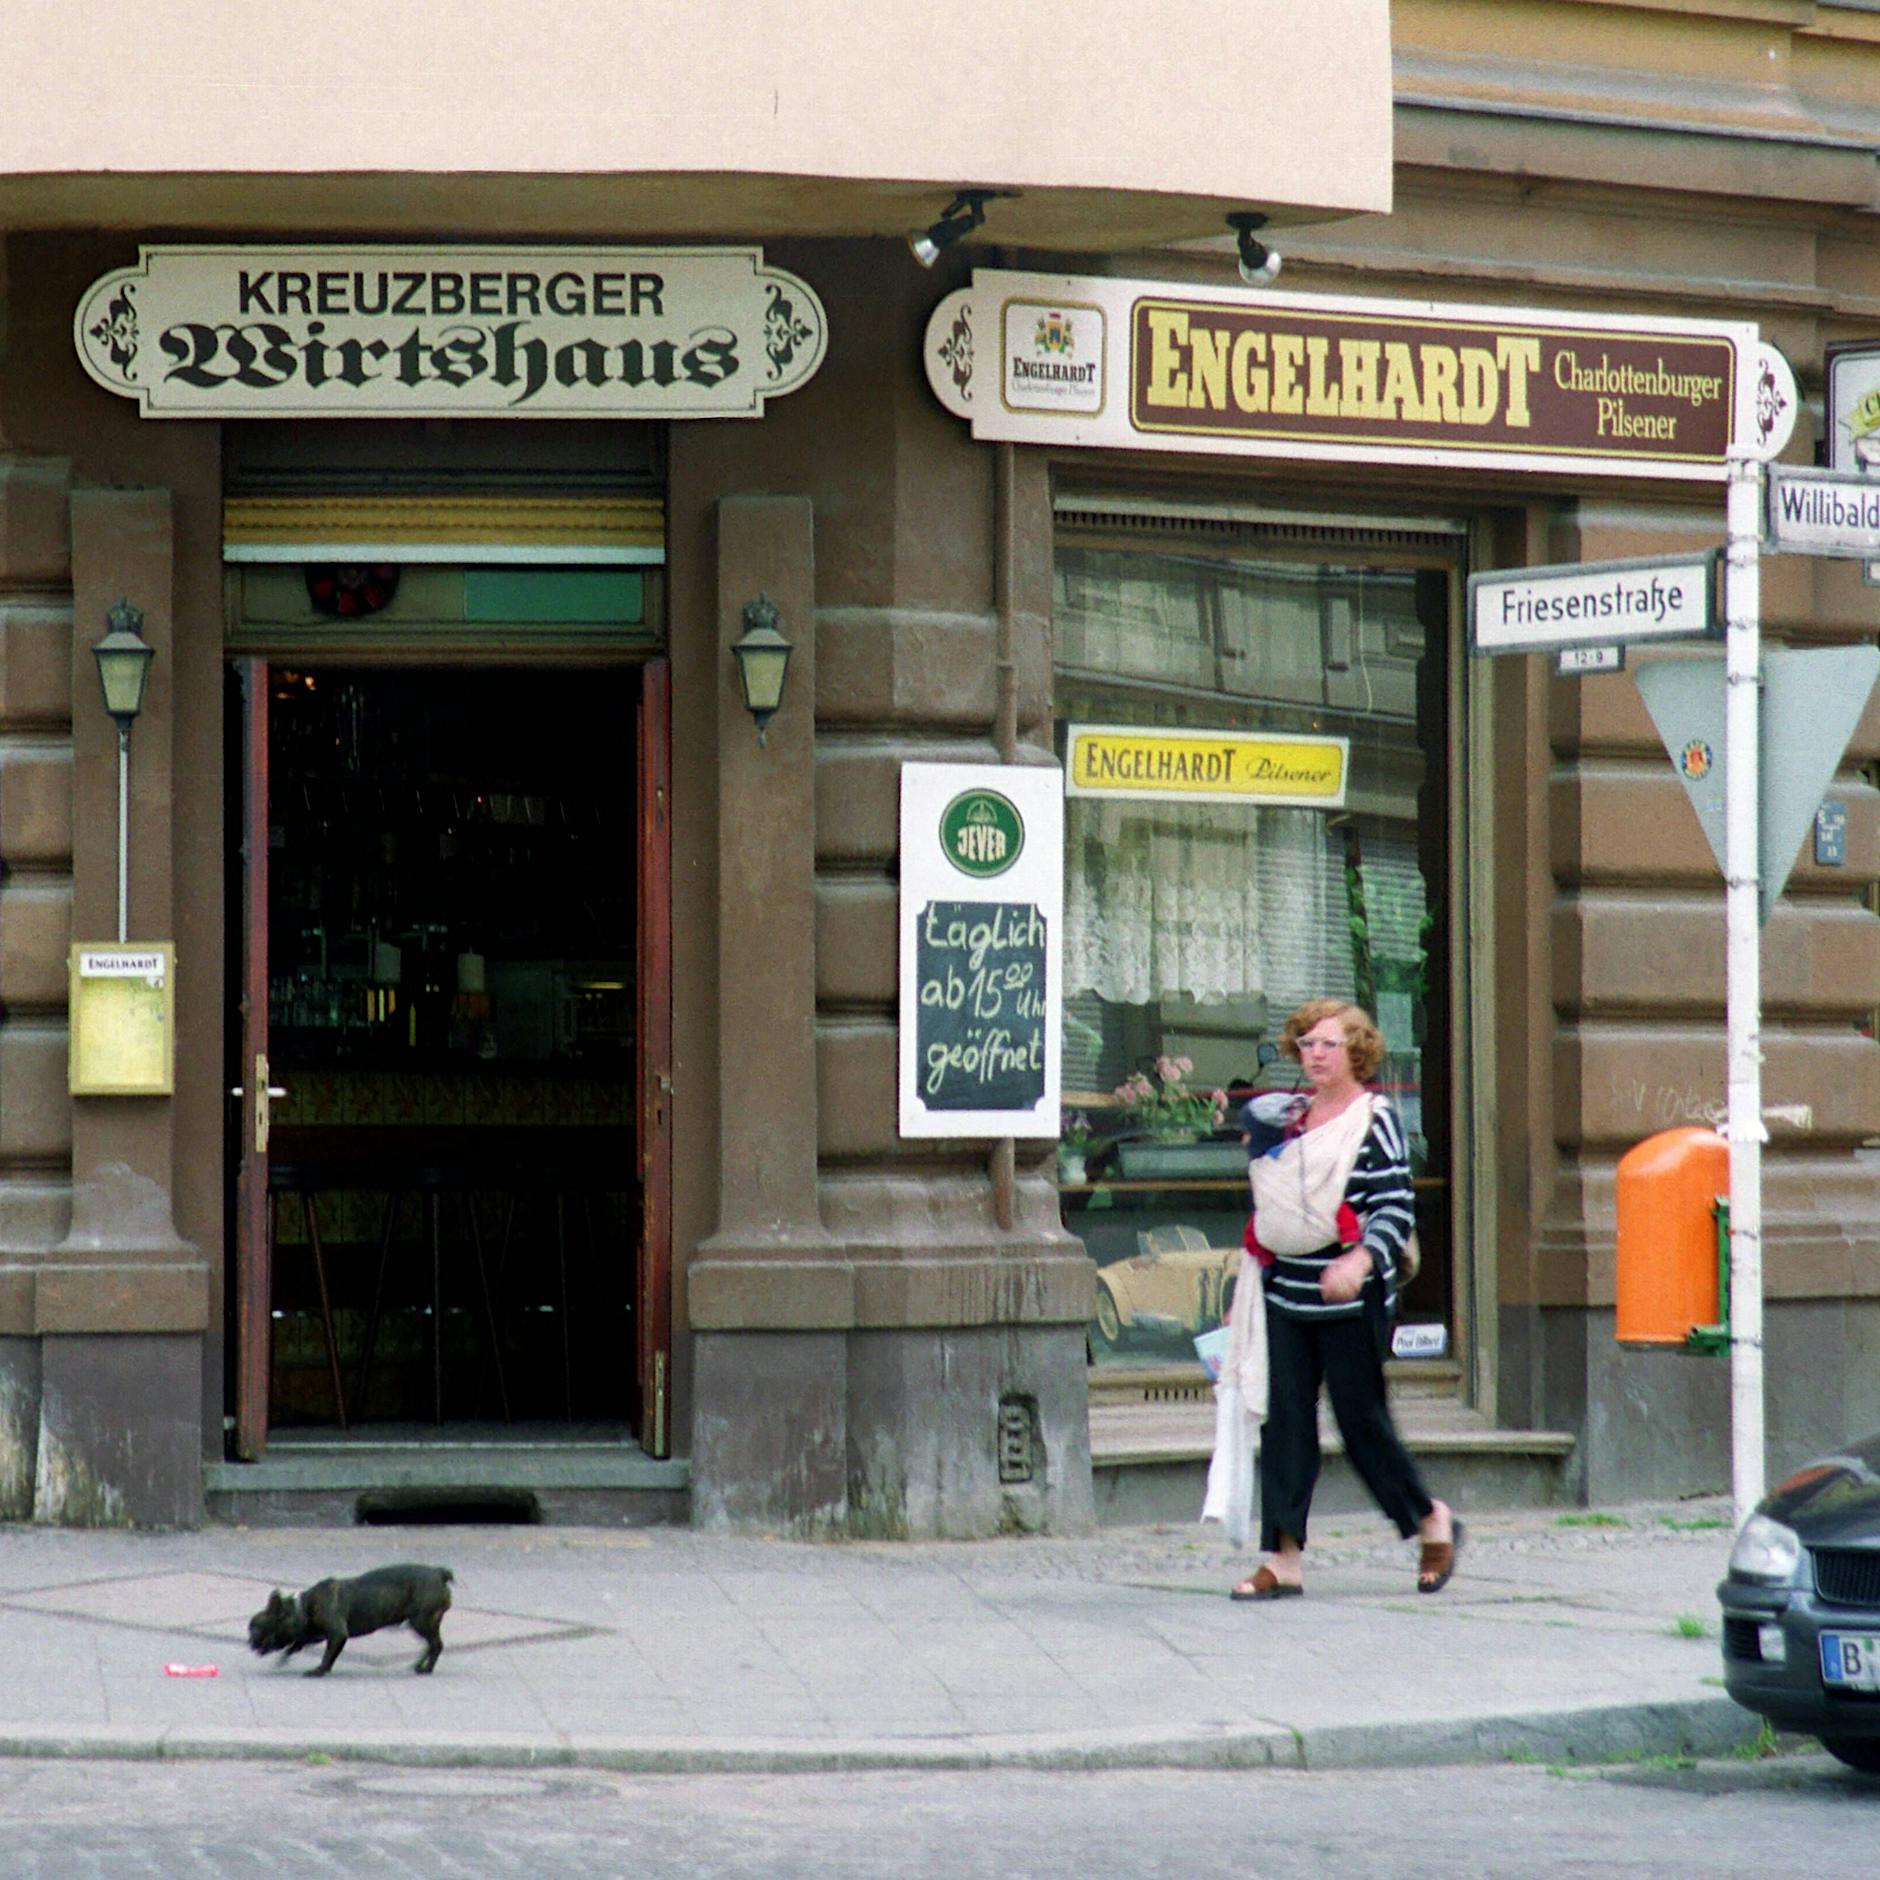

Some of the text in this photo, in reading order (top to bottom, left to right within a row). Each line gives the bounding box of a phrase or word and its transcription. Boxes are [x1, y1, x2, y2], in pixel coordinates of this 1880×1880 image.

[238, 270, 665, 317] KREUZBERGER
[158, 320, 741, 406] Wirtshaus
[1013, 357, 1096, 383] ENGELHARDT
[1147, 308, 1541, 428] ENGELHARDT
[1554, 349, 1723, 406] Charlottenburger
[1597, 398, 1678, 440] Pilsener
[1502, 577, 1683, 624] Friesenstraße
[1085, 742, 1332, 784] ENGELHARDT Pilsener
[957, 824, 1006, 862] JEVER
[925, 900, 1045, 971] täglich
[88, 957, 158, 970] ENGELHARDT
[920, 964, 966, 1010] ab
[926, 1027, 1042, 1095] geöffnet
